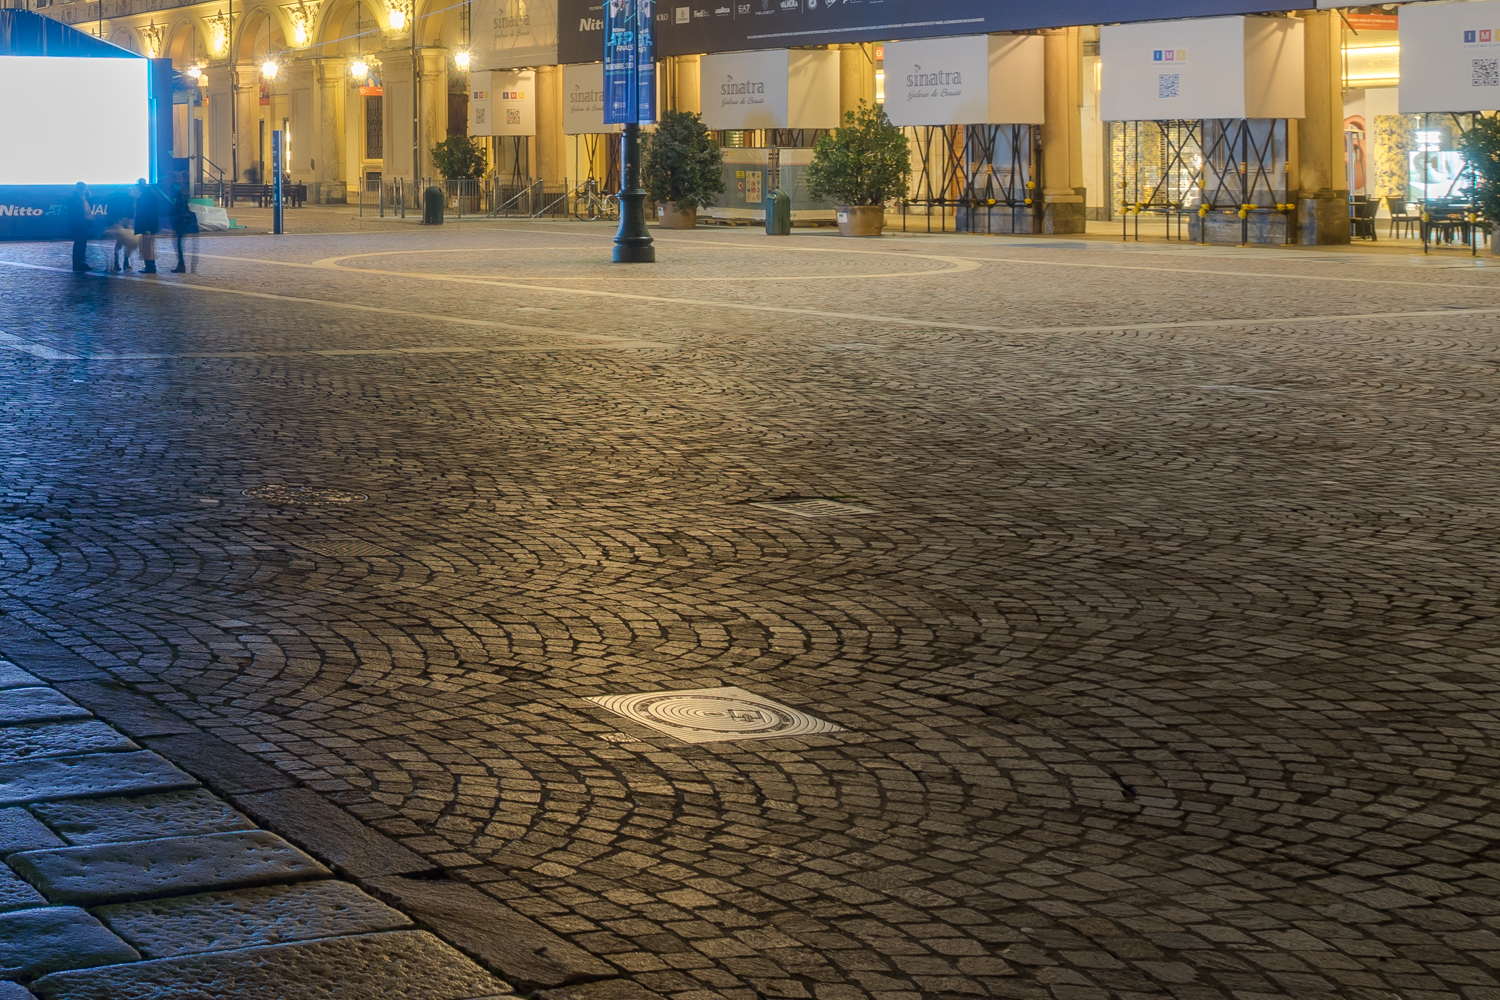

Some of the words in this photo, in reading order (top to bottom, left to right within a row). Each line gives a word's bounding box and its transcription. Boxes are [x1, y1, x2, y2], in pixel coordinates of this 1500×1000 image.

[579, 17, 604, 32] Nit
[906, 72, 962, 87] sinatra
[720, 81, 765, 95] sinatra
